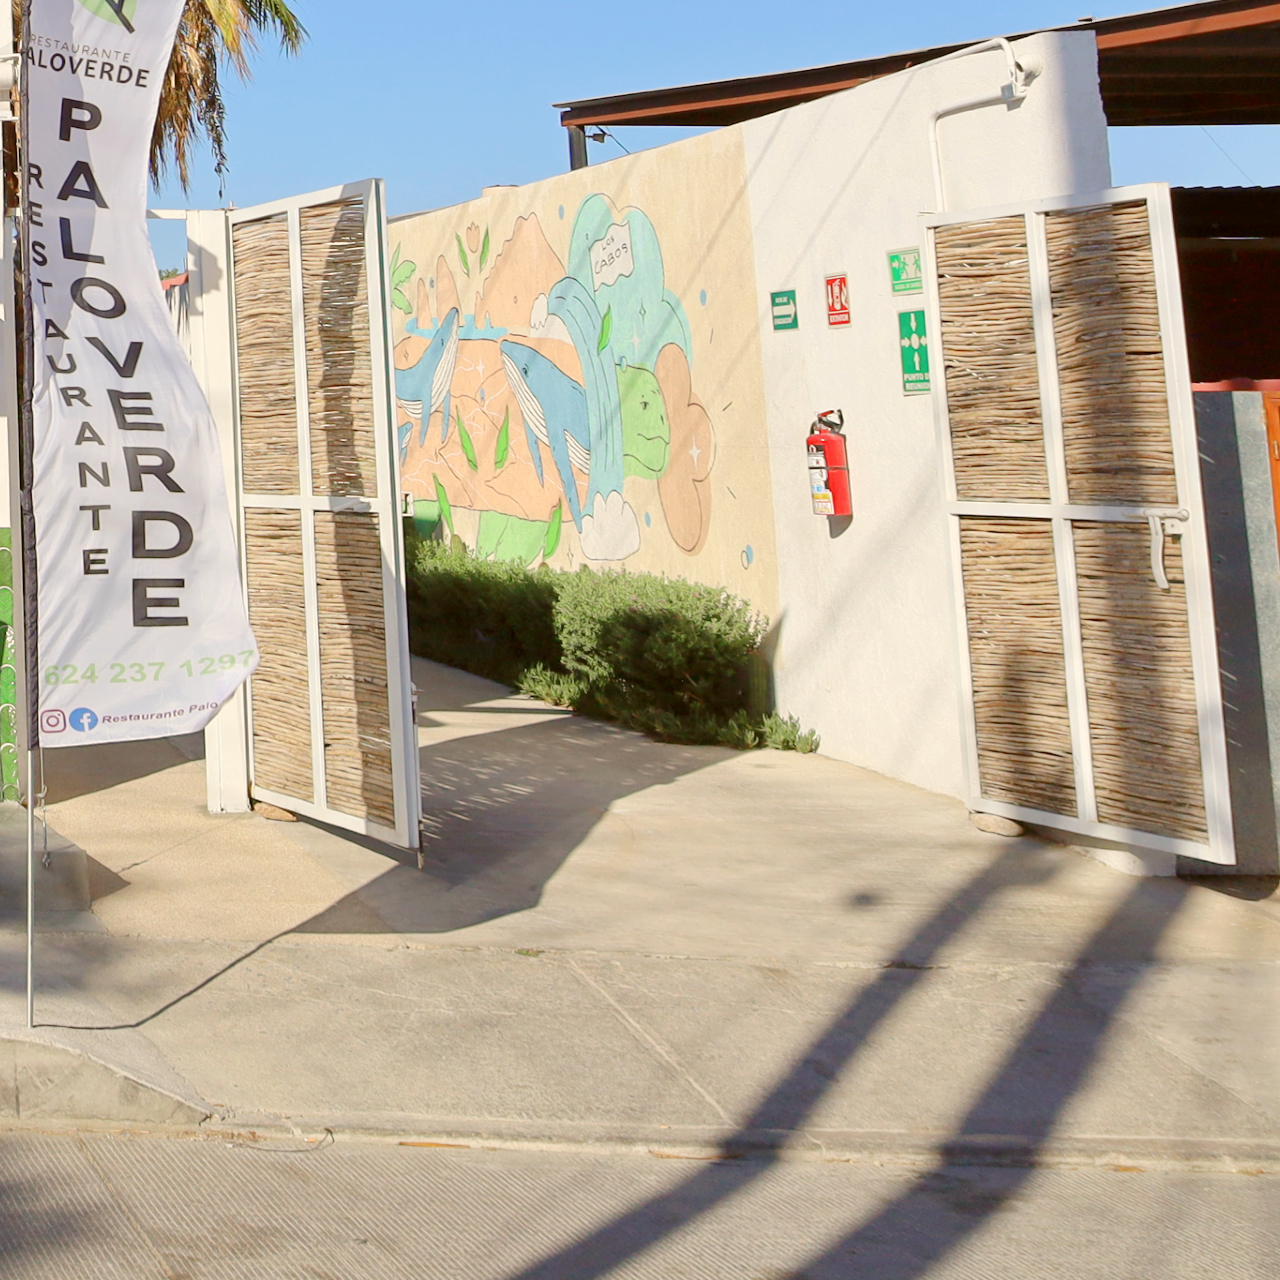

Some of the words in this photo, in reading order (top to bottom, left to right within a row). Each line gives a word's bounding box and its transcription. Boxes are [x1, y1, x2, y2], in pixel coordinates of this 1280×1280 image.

[29, 33, 132, 63] RESTAURANTE
[26, 46, 150, 88] ALOVERDE
[594, 243, 628, 275] CABOS
[601, 235, 615, 251] LOS
[57, 97, 194, 627] PALOVERDE
[44, 662, 99, 686] 624
[109, 661, 166, 684] 237
[179, 650, 255, 678] 1297
[101, 708, 185, 724] Restaurante
